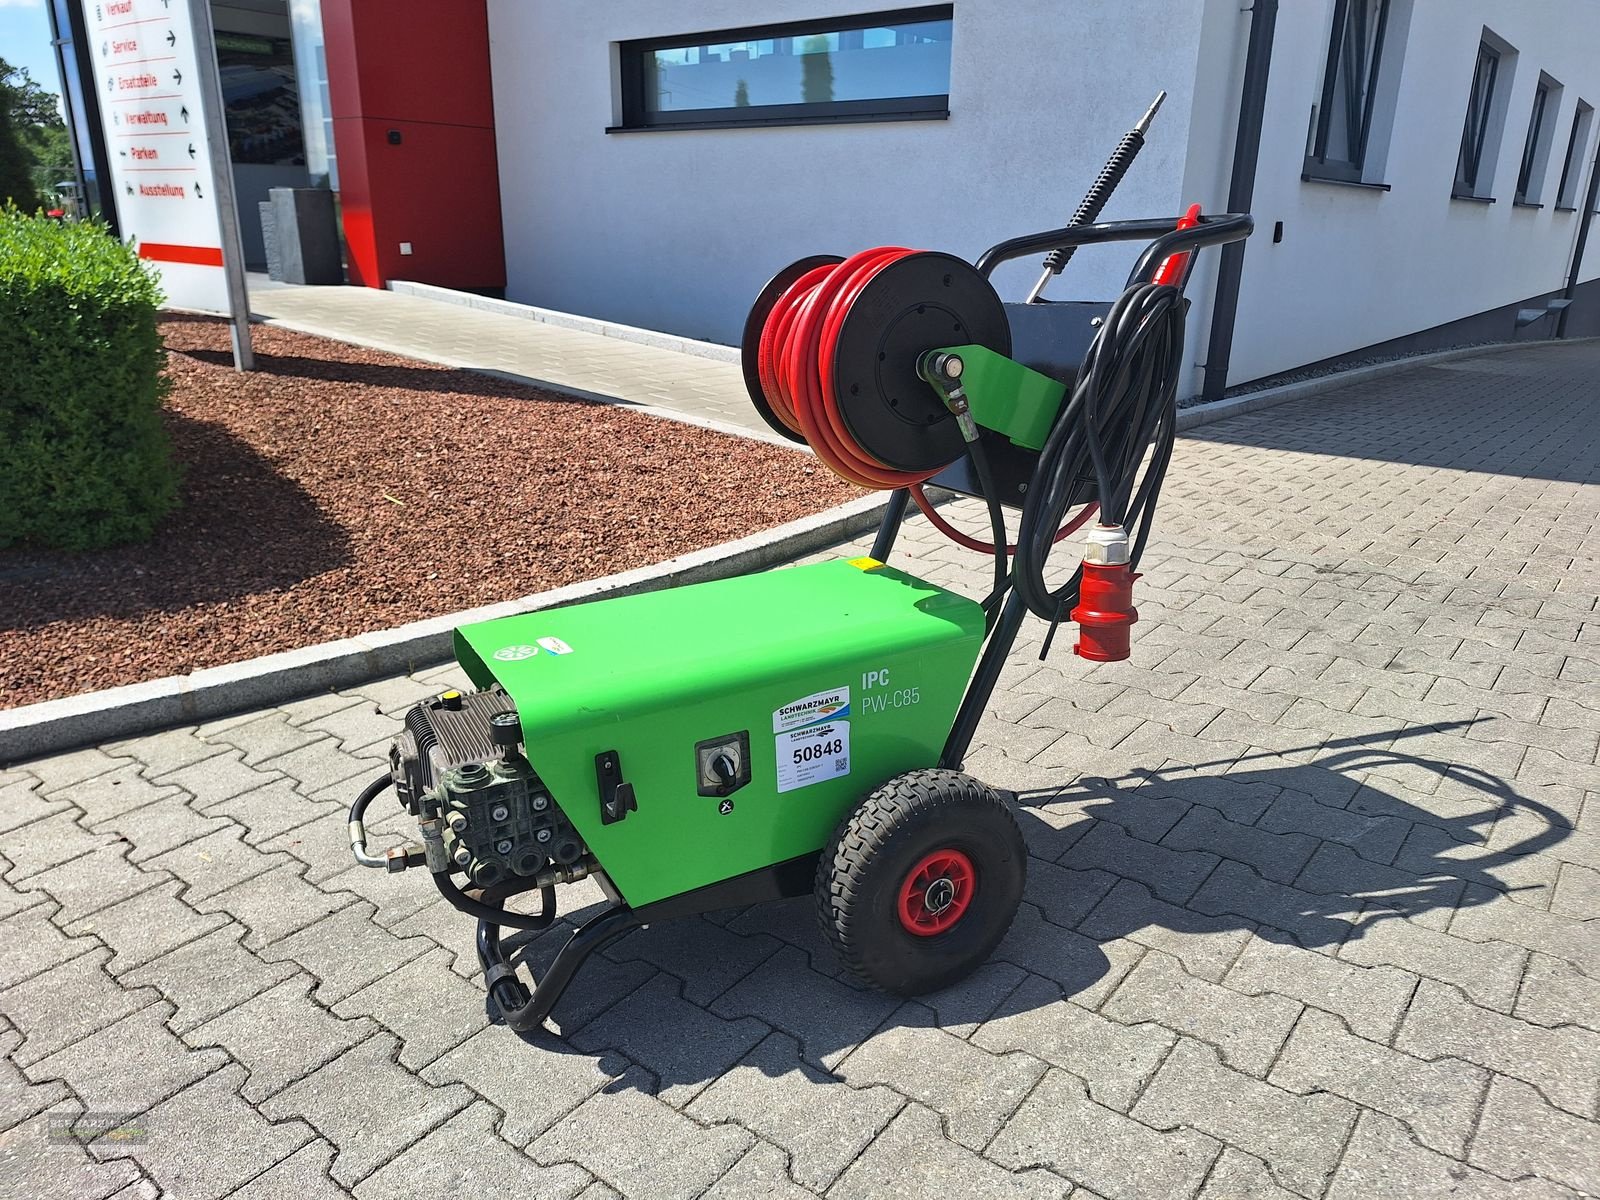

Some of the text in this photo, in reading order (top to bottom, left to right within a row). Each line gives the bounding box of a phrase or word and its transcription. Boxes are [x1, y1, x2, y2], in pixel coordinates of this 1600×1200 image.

[106, 0, 132, 15] Verkauf
[112, 40, 138, 54] Service
[119, 75, 158, 90] Ersatzteile
[125, 111, 167, 126] Verwaltung
[131, 146, 159, 160] Parken
[139, 183, 185, 200] Ausstellung
[862, 669, 889, 690] IPC
[779, 696, 839, 715] SCHWARZMAYR
[862, 687, 920, 716] PW-C85
[780, 709, 817, 721] LANDTECHNIK
[790, 725, 831, 739] SCHWARZMAYR
[793, 739, 842, 764] 50848
